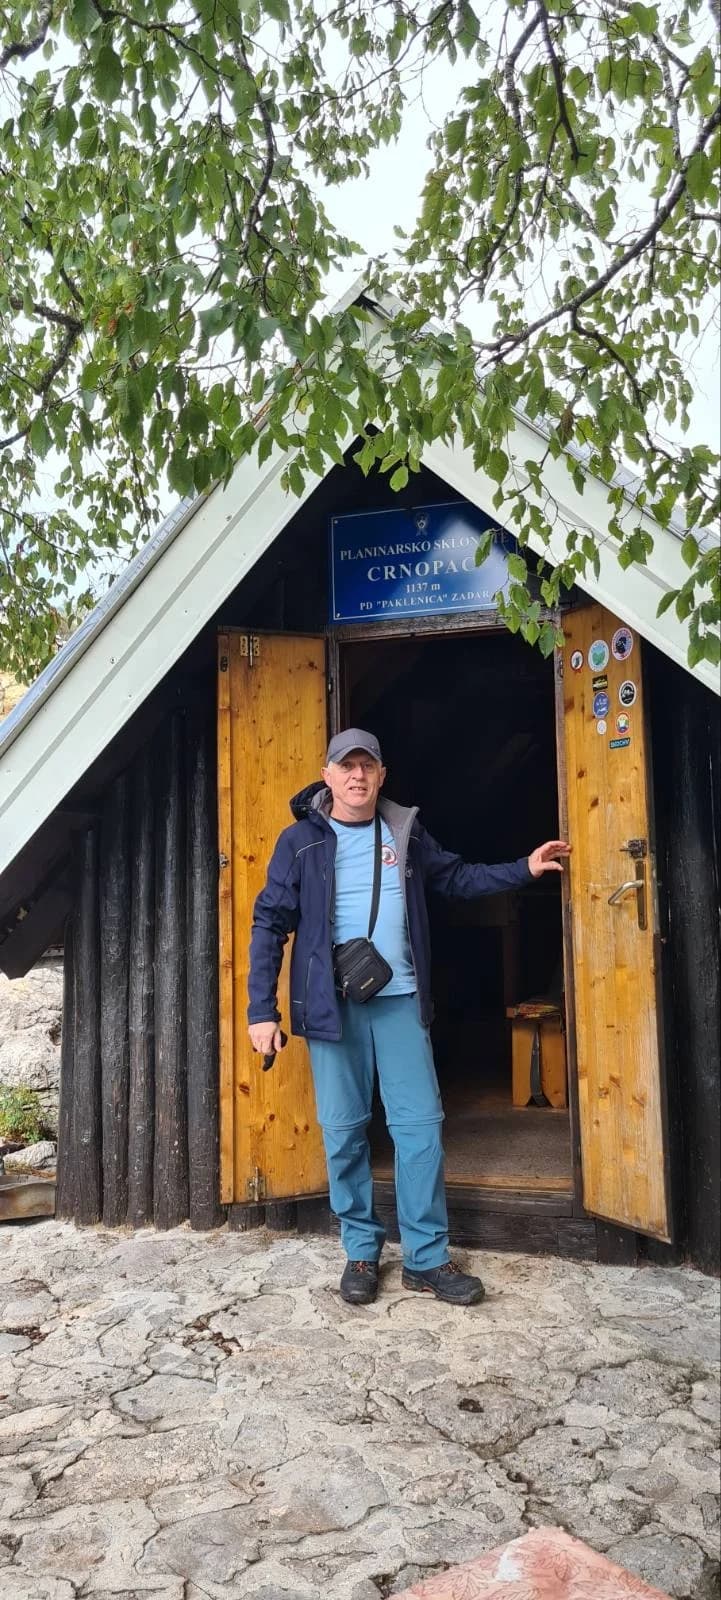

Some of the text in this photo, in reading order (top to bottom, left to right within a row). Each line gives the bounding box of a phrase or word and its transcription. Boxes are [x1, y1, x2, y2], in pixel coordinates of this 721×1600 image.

[340, 540, 431, 561] PLANINARSKO
[367, 556, 474, 582] CRNOPAC
[406, 582, 441, 594] 1137 m
[360, 590, 490, 611] PD "PAKLENICA" ZADAR
